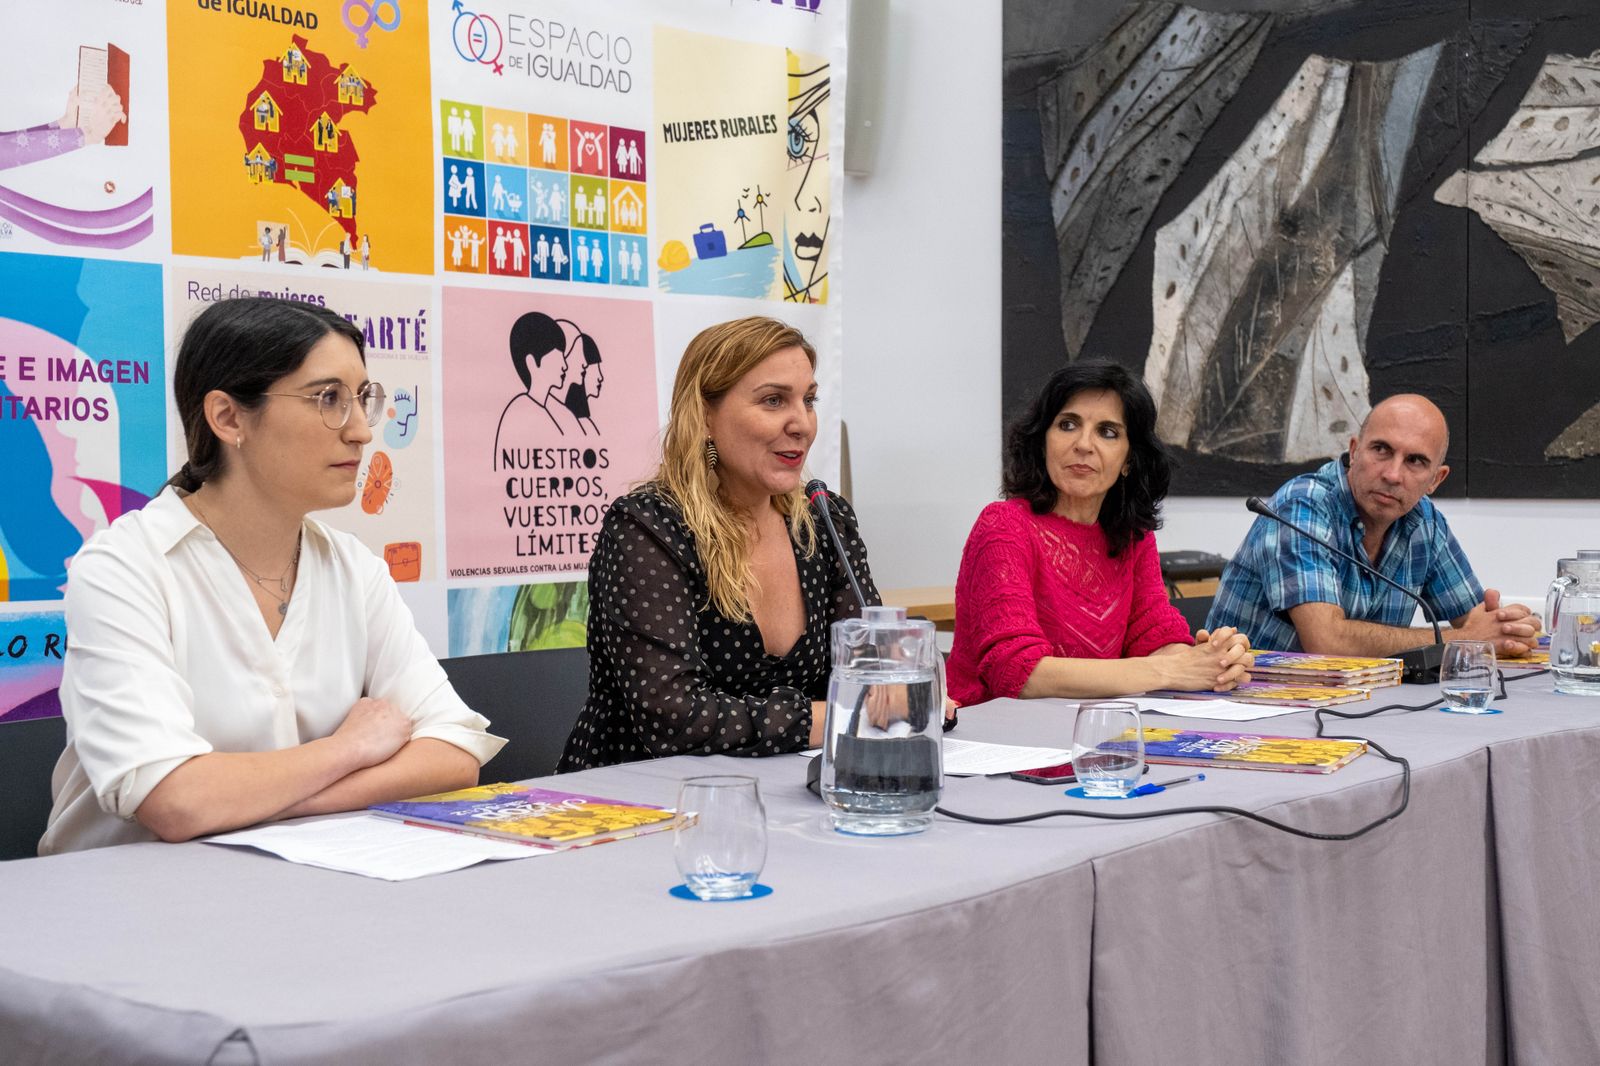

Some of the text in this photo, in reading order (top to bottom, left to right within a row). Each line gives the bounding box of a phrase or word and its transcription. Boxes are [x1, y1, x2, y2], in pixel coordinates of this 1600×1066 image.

[227, 0, 319, 30] IGUALDAD
[508, 14, 632, 64] ESPACIO
[508, 52, 632, 94] DE IGUALDAD
[662, 114, 778, 143] MUJERES RURALES
[188, 281, 222, 301] Red
[229, 284, 250, 300] de
[19, 357, 36, 381] E
[48, 357, 149, 384] IMAGEN
[502, 448, 610, 470] NUESTROS
[506, 476, 608, 500] CUERPOS,
[450, 562, 589, 577] VIOLENCIAS SEXUALES CONTRA LAS MUJ
